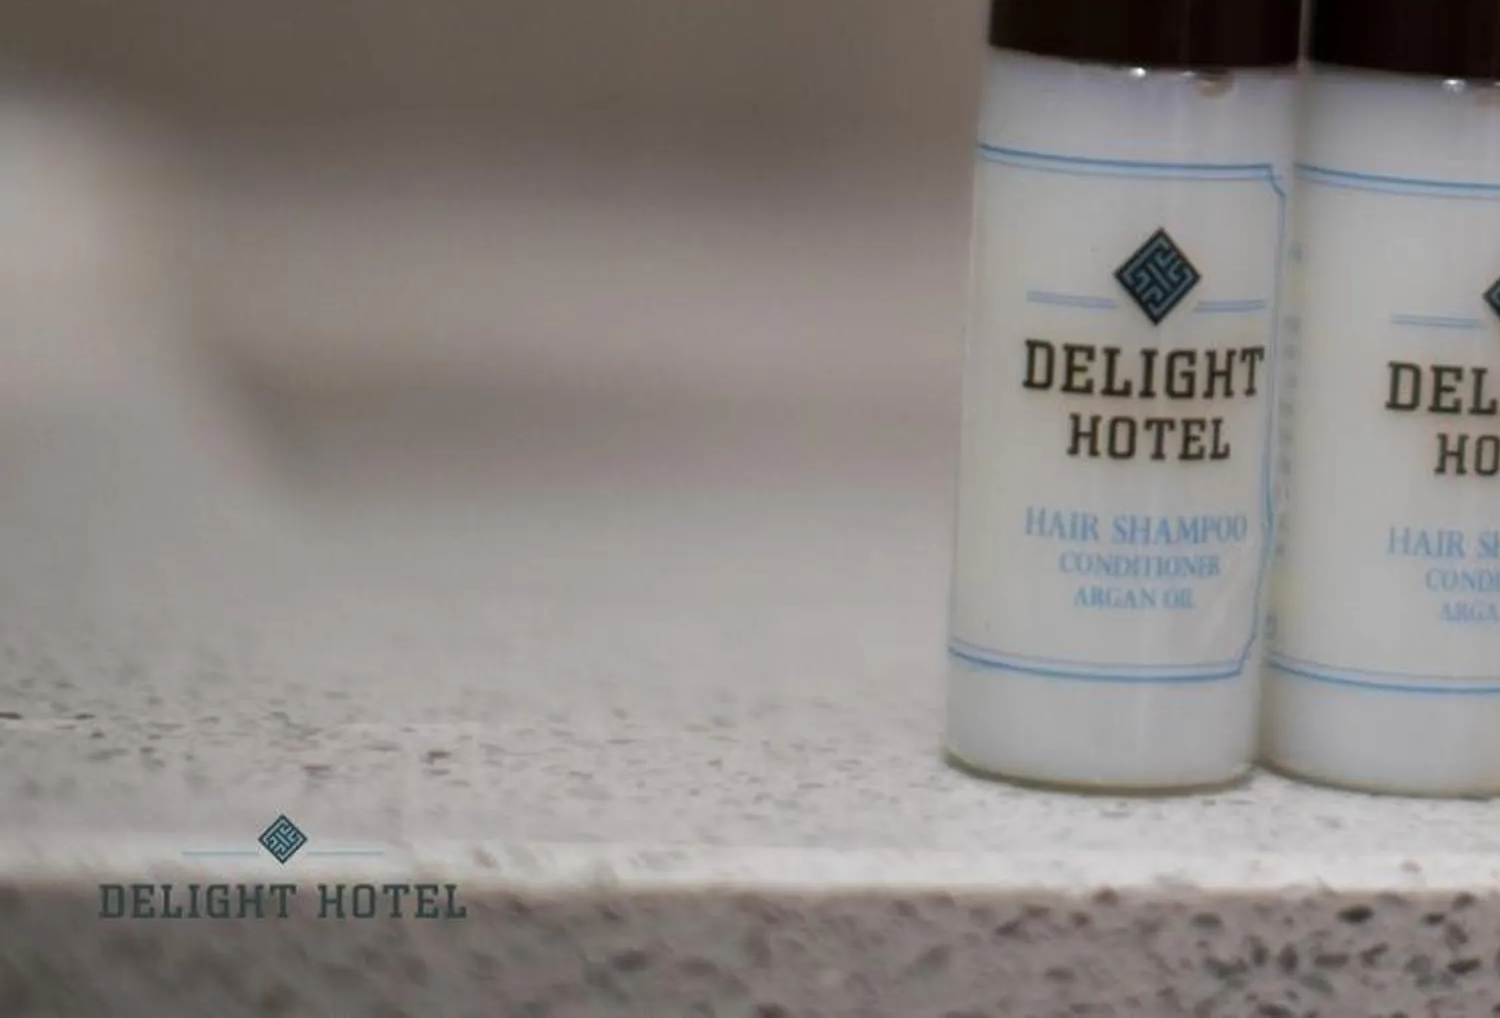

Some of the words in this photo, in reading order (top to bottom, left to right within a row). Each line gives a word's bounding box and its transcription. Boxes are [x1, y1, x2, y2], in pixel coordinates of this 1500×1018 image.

[1022, 338, 1265, 400] DELIGHT
[1067, 412, 1231, 462] HOTEL
[1024, 506, 1099, 541] HAIR
[1110, 513, 1248, 545] SHAMPOO
[1386, 526, 1466, 559] HAIR
[1059, 551, 1221, 578] CONDITIONER
[1074, 586, 1157, 609] ARGAN
